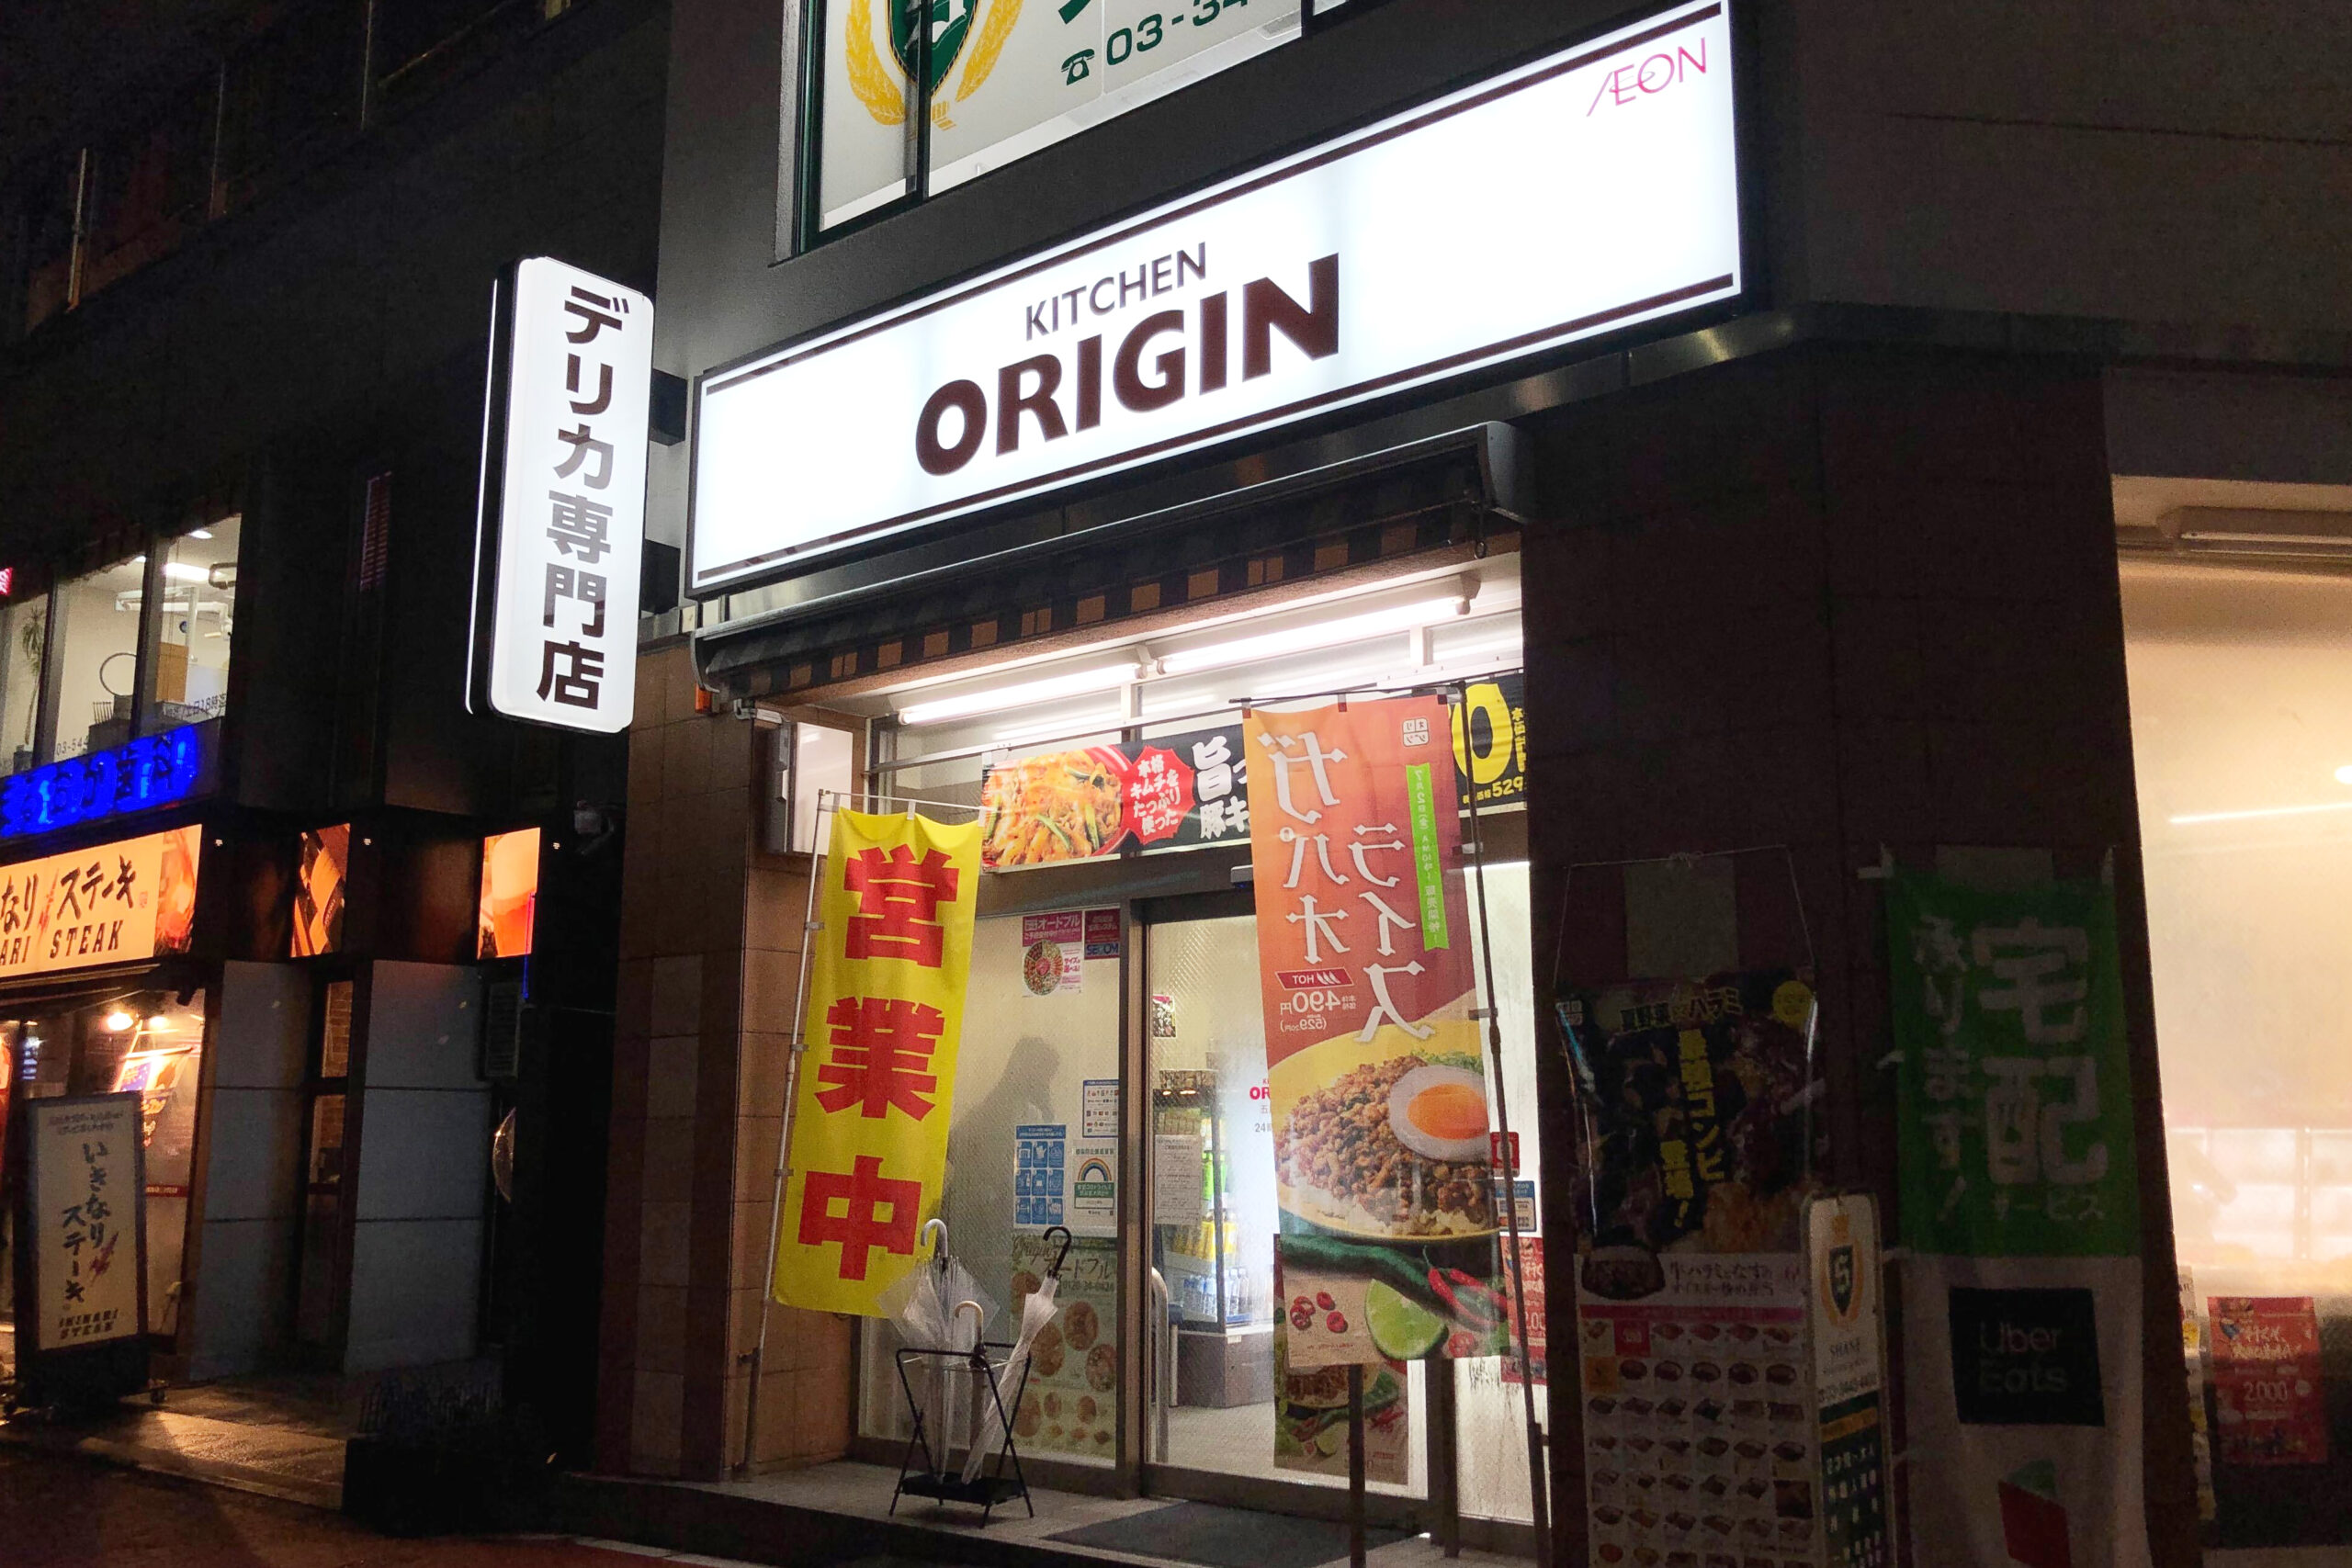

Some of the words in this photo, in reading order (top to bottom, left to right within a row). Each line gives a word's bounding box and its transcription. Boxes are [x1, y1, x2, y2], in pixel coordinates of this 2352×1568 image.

[1106, 0, 1248, 65] 03-3
[1025, 242, 1205, 342] KITCHEN
[915, 253, 1339, 477] ORIGIN
[537, 285, 629, 711] デリカ専門店
[1130, 768, 1179, 799] キムチを
[1137, 754, 1164, 778] 本格
[1134, 786, 1181, 818] たっぷり
[1142, 808, 1179, 836] 使った
[57, 854, 136, 920] ステーキ
[50, 919, 124, 959] STEAK
[1087, 942, 1118, 955] SEOM
[797, 842, 960, 1281] 営業中
[1971, 916, 2109, 1185] 宅配
[62, 1205, 87, 1303] ステーキ
[1979, 1320, 2064, 1355] Uber
[1978, 1356, 2069, 1395] Eats
